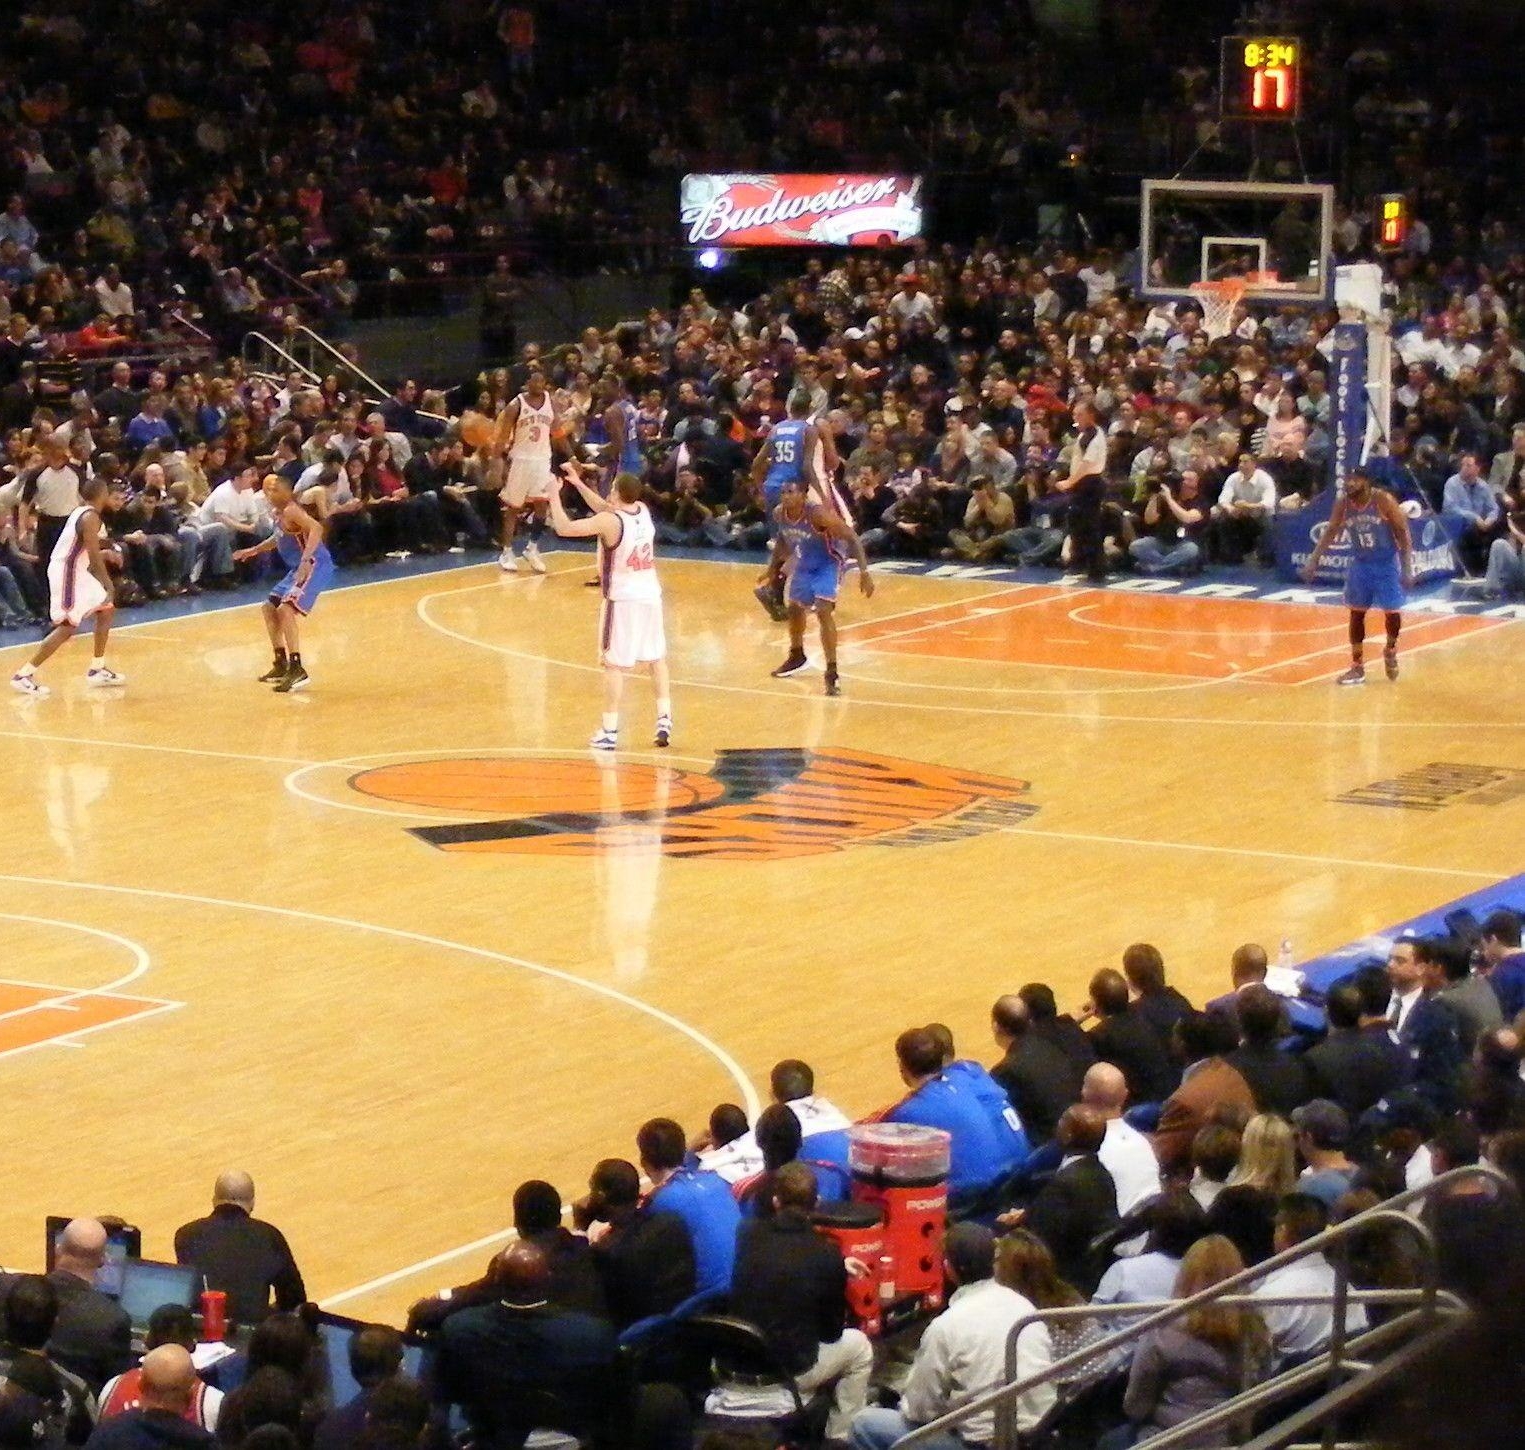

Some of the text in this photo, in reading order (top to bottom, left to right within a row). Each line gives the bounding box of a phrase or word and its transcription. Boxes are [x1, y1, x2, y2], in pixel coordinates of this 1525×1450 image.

[1244, 43, 1293, 68] 8:34
[1253, 69, 1286, 109] 17
[680, 176, 899, 244] Budweiser
[529, 426, 541, 443] 3
[774, 440, 796, 463] 35
[1358, 532, 1374, 548] 13
